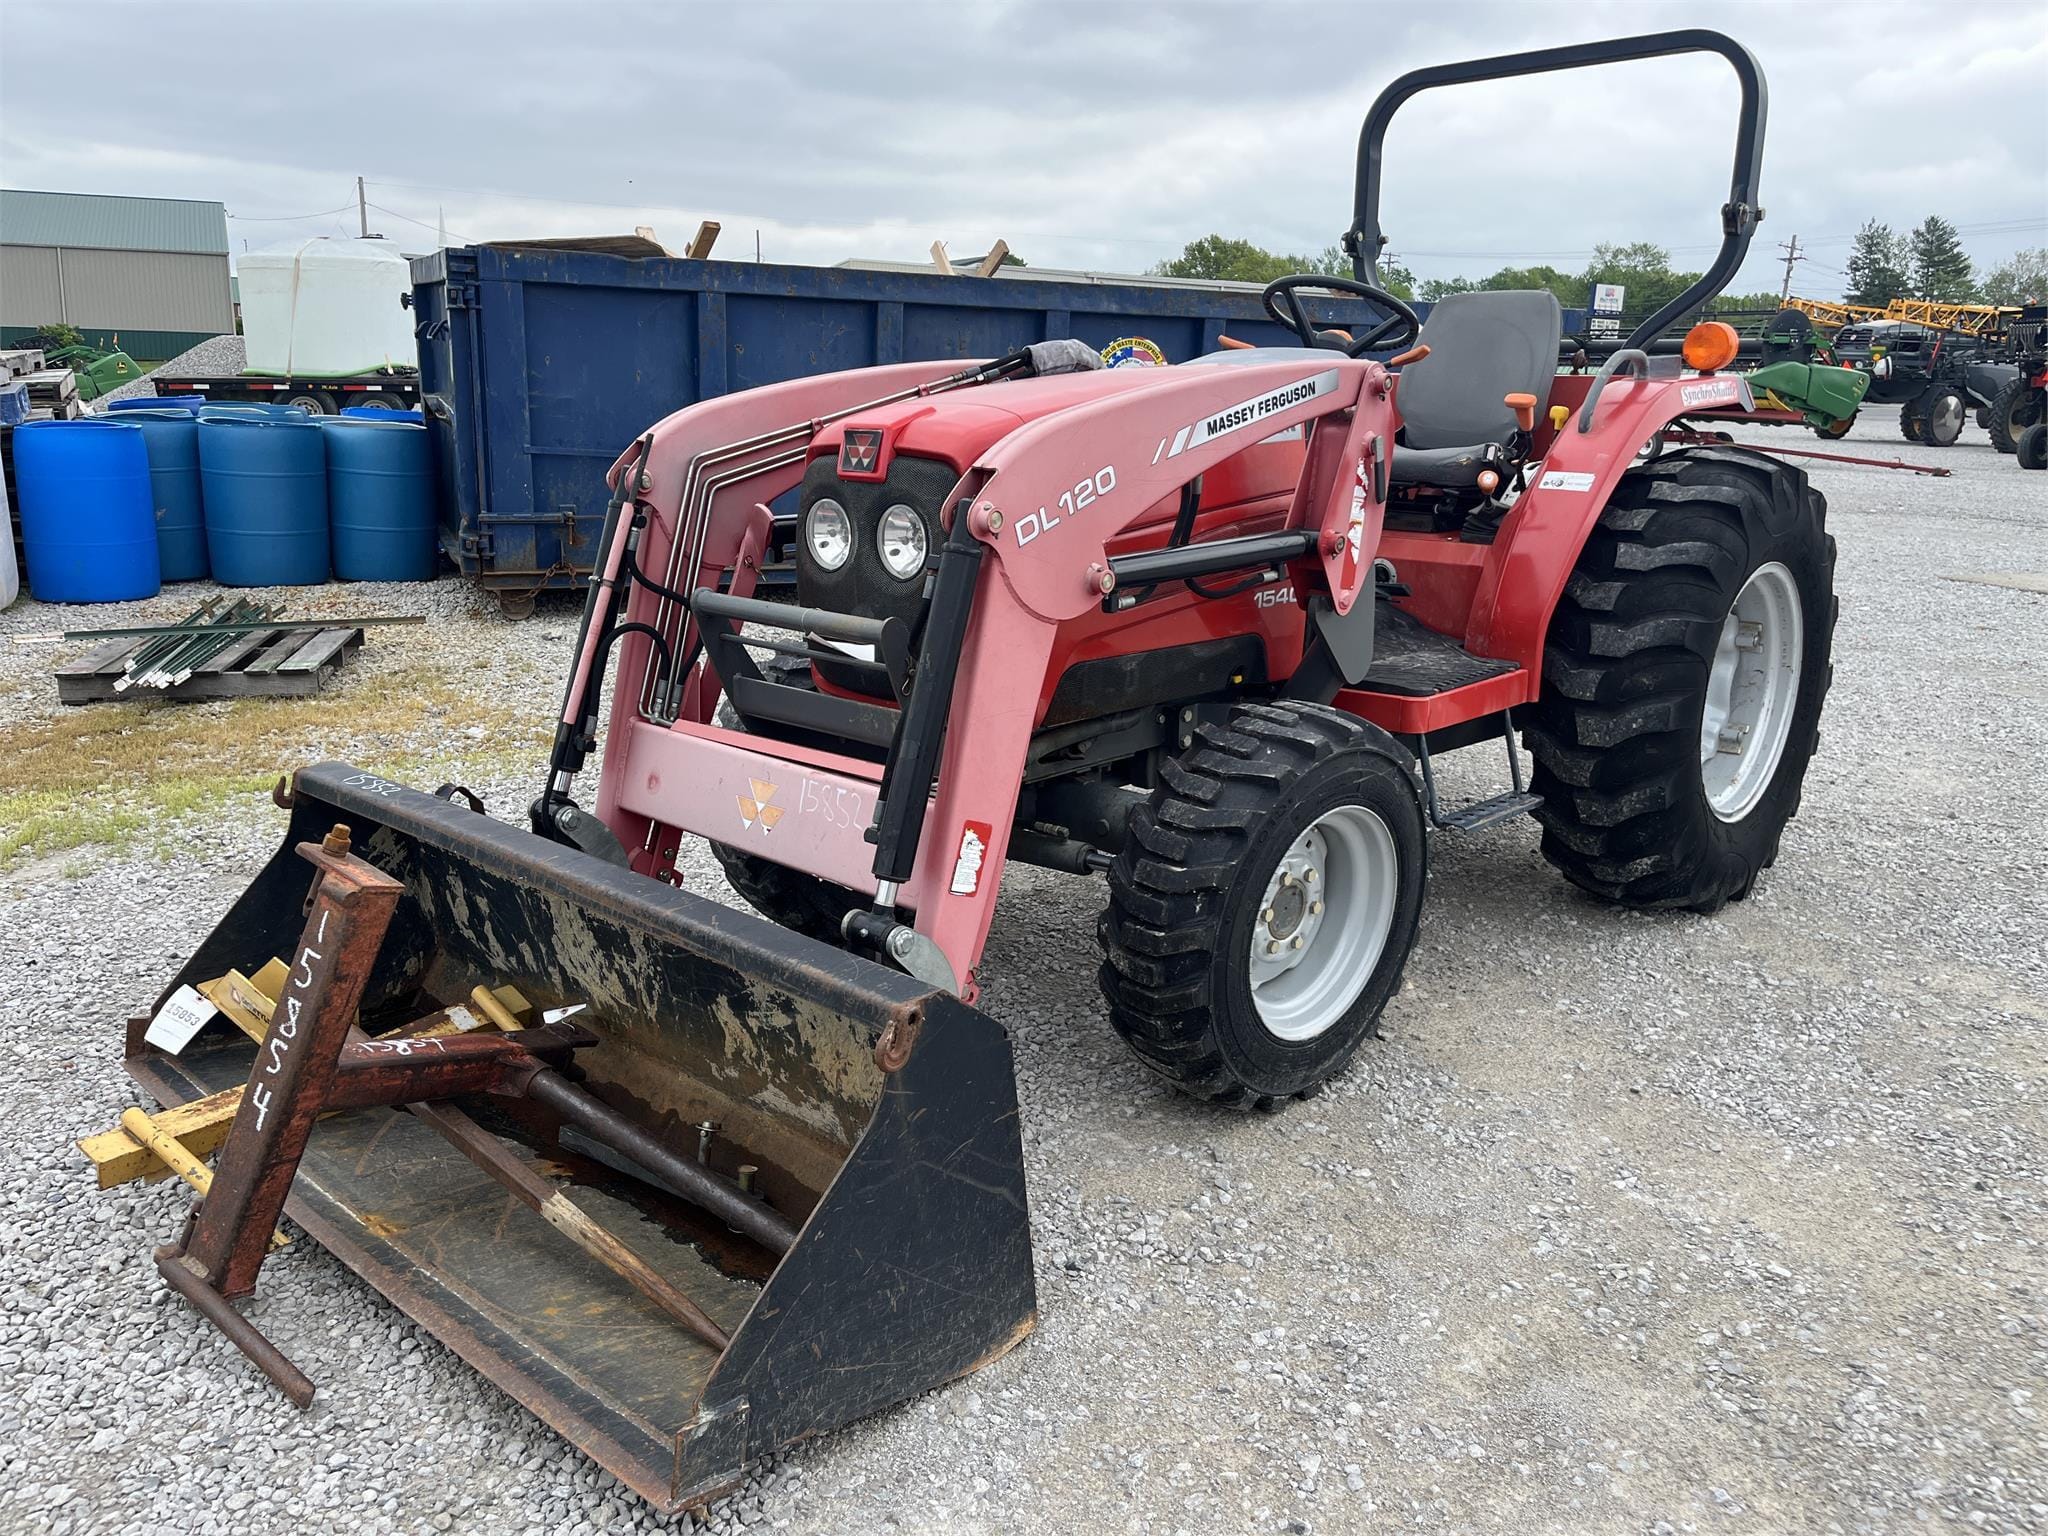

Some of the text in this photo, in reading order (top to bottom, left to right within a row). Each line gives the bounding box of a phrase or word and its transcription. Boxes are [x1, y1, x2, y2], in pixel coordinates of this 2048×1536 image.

[1117, 339, 1133, 349] WASTE
[1206, 380, 1317, 437] MASSEY FERGUSON
[343, 773, 402, 797] 15852
[799, 777, 864, 829] 15852
[165, 1002, 201, 1027] 15853
